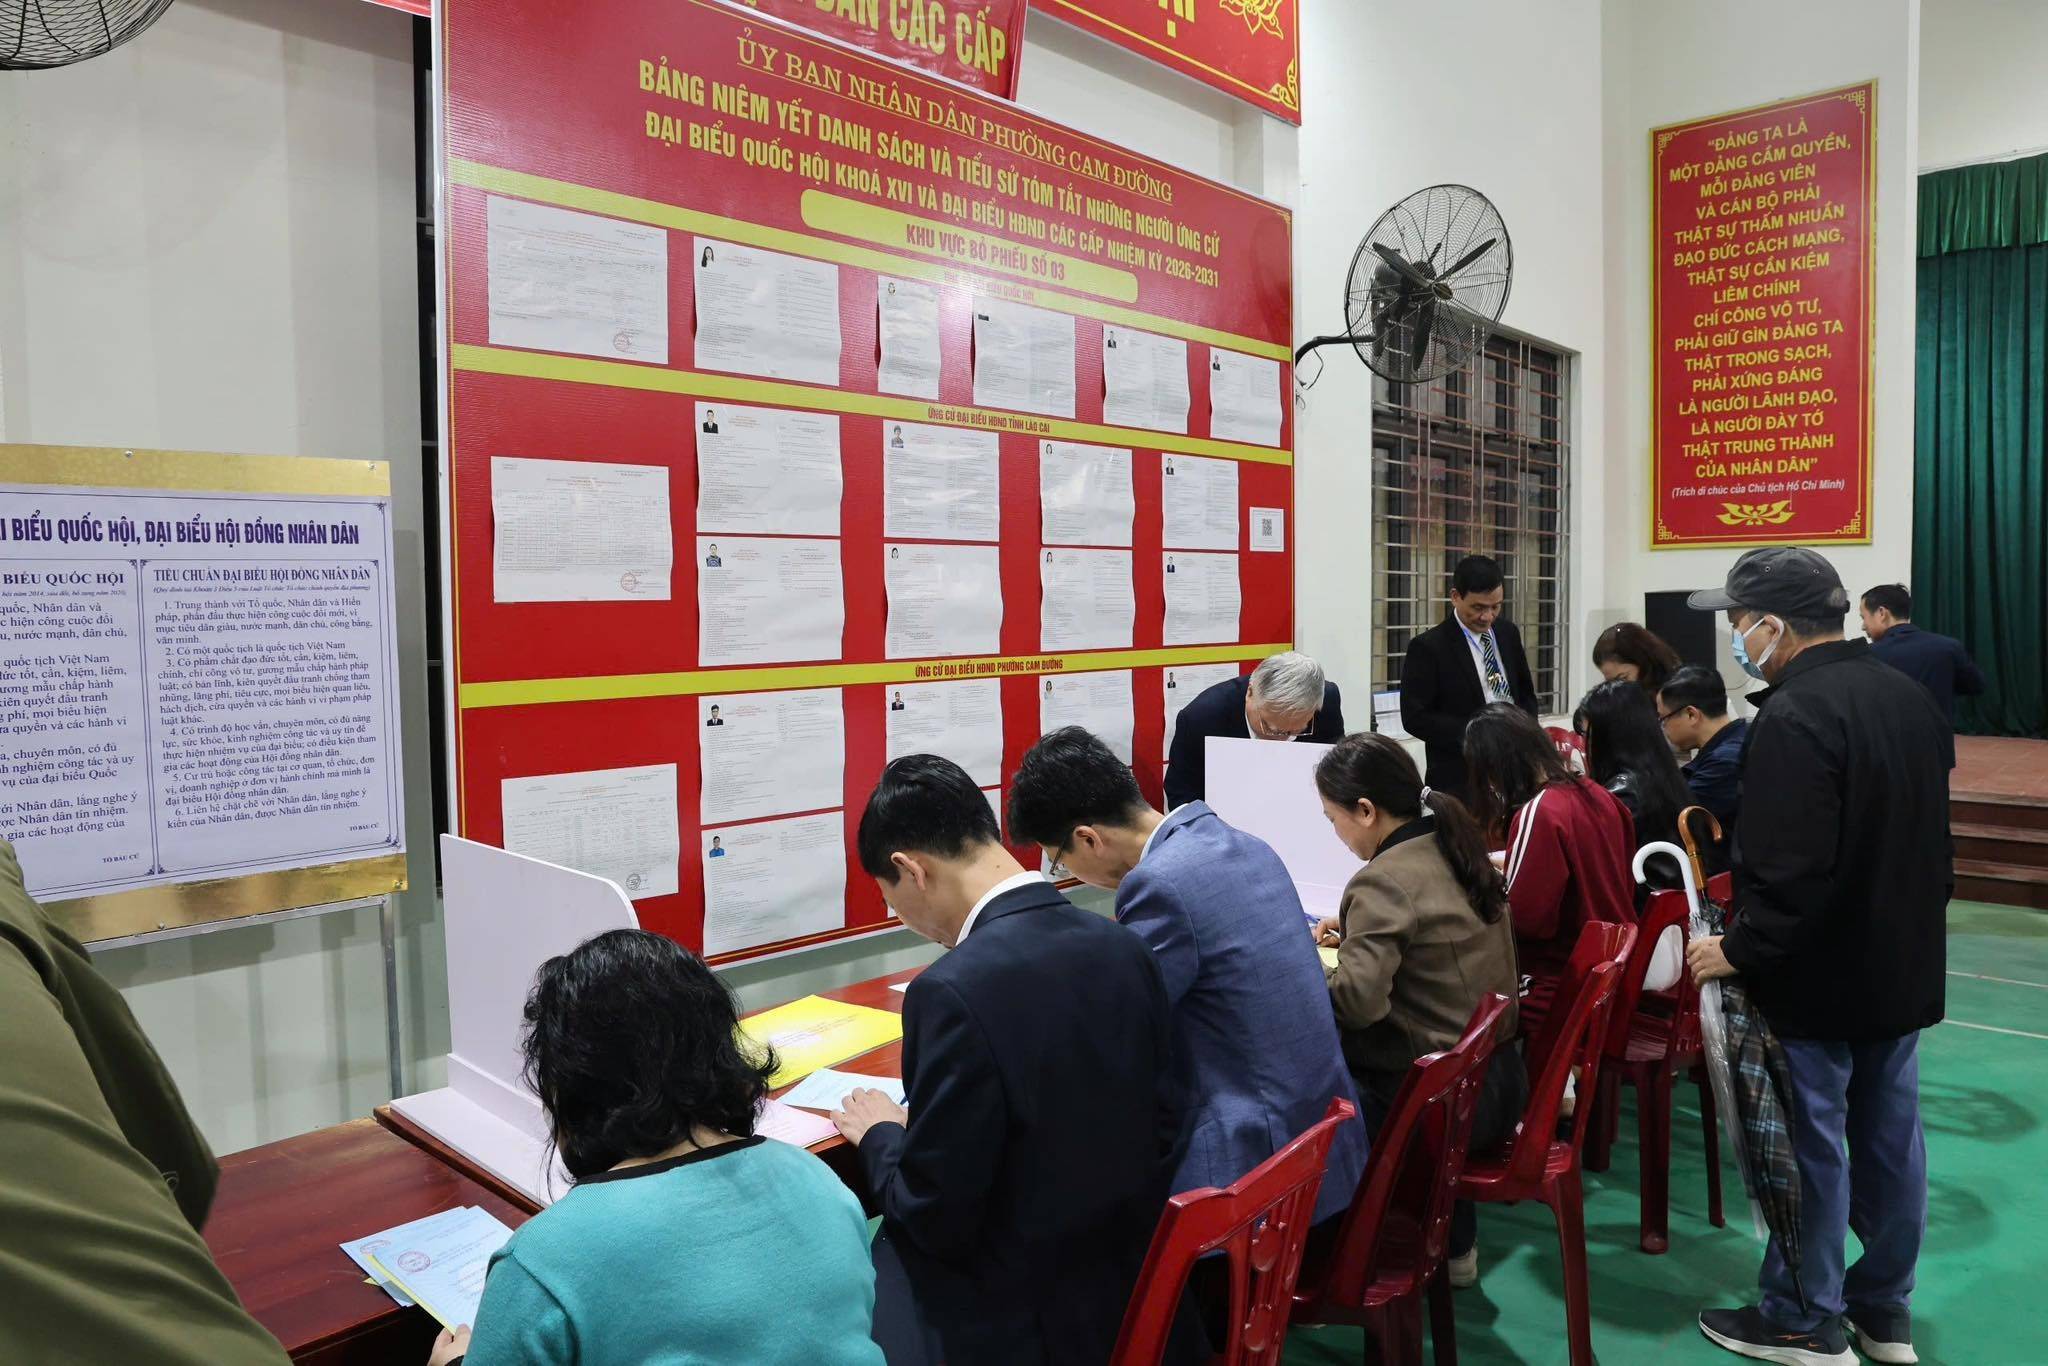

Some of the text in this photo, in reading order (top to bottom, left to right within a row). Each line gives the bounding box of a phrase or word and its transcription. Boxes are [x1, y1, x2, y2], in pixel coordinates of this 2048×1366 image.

[956, 6, 1006, 77] CẤP
[738, 28, 1172, 201] ỦY BAN NHÂN DÂN PHƯỜNG CAM ĐƯỜNG
[1709, 117, 1808, 151] “ĐẢNG TA LÀ
[640, 56, 1220, 257] BẢNG NIÊM YẾT DANH SÁCH VÀ TIỂU SỬ TÓM TẮT NHỮNG NGƯỜI ỨNG CỬ
[1670, 163, 1700, 182] MỘT
[1704, 155, 1748, 178] ĐẢNG
[1701, 163, 1815, 197] MỖI ĐẢNG VIÊN
[646, 112, 1218, 287] ĐẠI BIỂU QUỐC HỘI KHOÁ XVI VÀ ĐẠI BIỂU HĐND CÁC CẤP NHIỆM KỲ 2026-2031
[1697, 183, 1821, 219] VÀ CÁN BỘ PHẢI
[1674, 225, 1712, 244] THẬT
[1717, 222, 1737, 239] SỰ
[1741, 211, 1783, 233] THẤM
[906, 224, 1065, 280] KHU VỰC BỎ PHIẾU SỐ 03
[1674, 229, 1844, 267] ĐẠO ĐỨC CÁCH MẠNG,
[1688, 251, 1830, 285] THẬT SỰ CẦN KIỆM
[1714, 280, 1800, 303] LIÊM CHÍNH
[1694, 298, 1821, 328] CHÍ CÔNG VÔ TƯ,
[1675, 320, 1843, 351] PHẢI GIỮ GÌN ĐẢNG TA
[1685, 344, 1831, 372] THẬT TRONG SẠCH,
[1693, 367, 1822, 392] PHẢI XỨNG ĐÁNG
[1680, 389, 1837, 415] LÀ NGƯỜI LÃNH ĐẠO,
[1692, 419, 1710, 435] LÀ
[1714, 415, 1762, 433] NGƯỜI
[1803, 409, 1824, 426] TỚ
[1682, 433, 1834, 461] THẬT TRUNG THÀNH
[1696, 456, 1817, 478] CỦA NHÂN DÂN”
[12, 510, 52, 541] BIỂU
[58, 512, 103, 544] QUỐC
[108, 516, 140, 547] HỘI,
[145, 521, 171, 547] ĐẠI
[176, 514, 210, 543] BIỂU
[216, 519, 240, 547] HỘI
[245, 516, 284, 543] ĐỒNG
[288, 520, 327, 543] NHÂN
[331, 521, 359, 544] DÂN
[4, 571, 123, 586] BIỂU QUỐC HỘI
[154, 566, 370, 583] TIÊU CHUẨN ĐẠI BIỂU HỘI ĐỒNG NHÂN DÂN
[4, 654, 110, 669] quốc tịch Việt Nam
